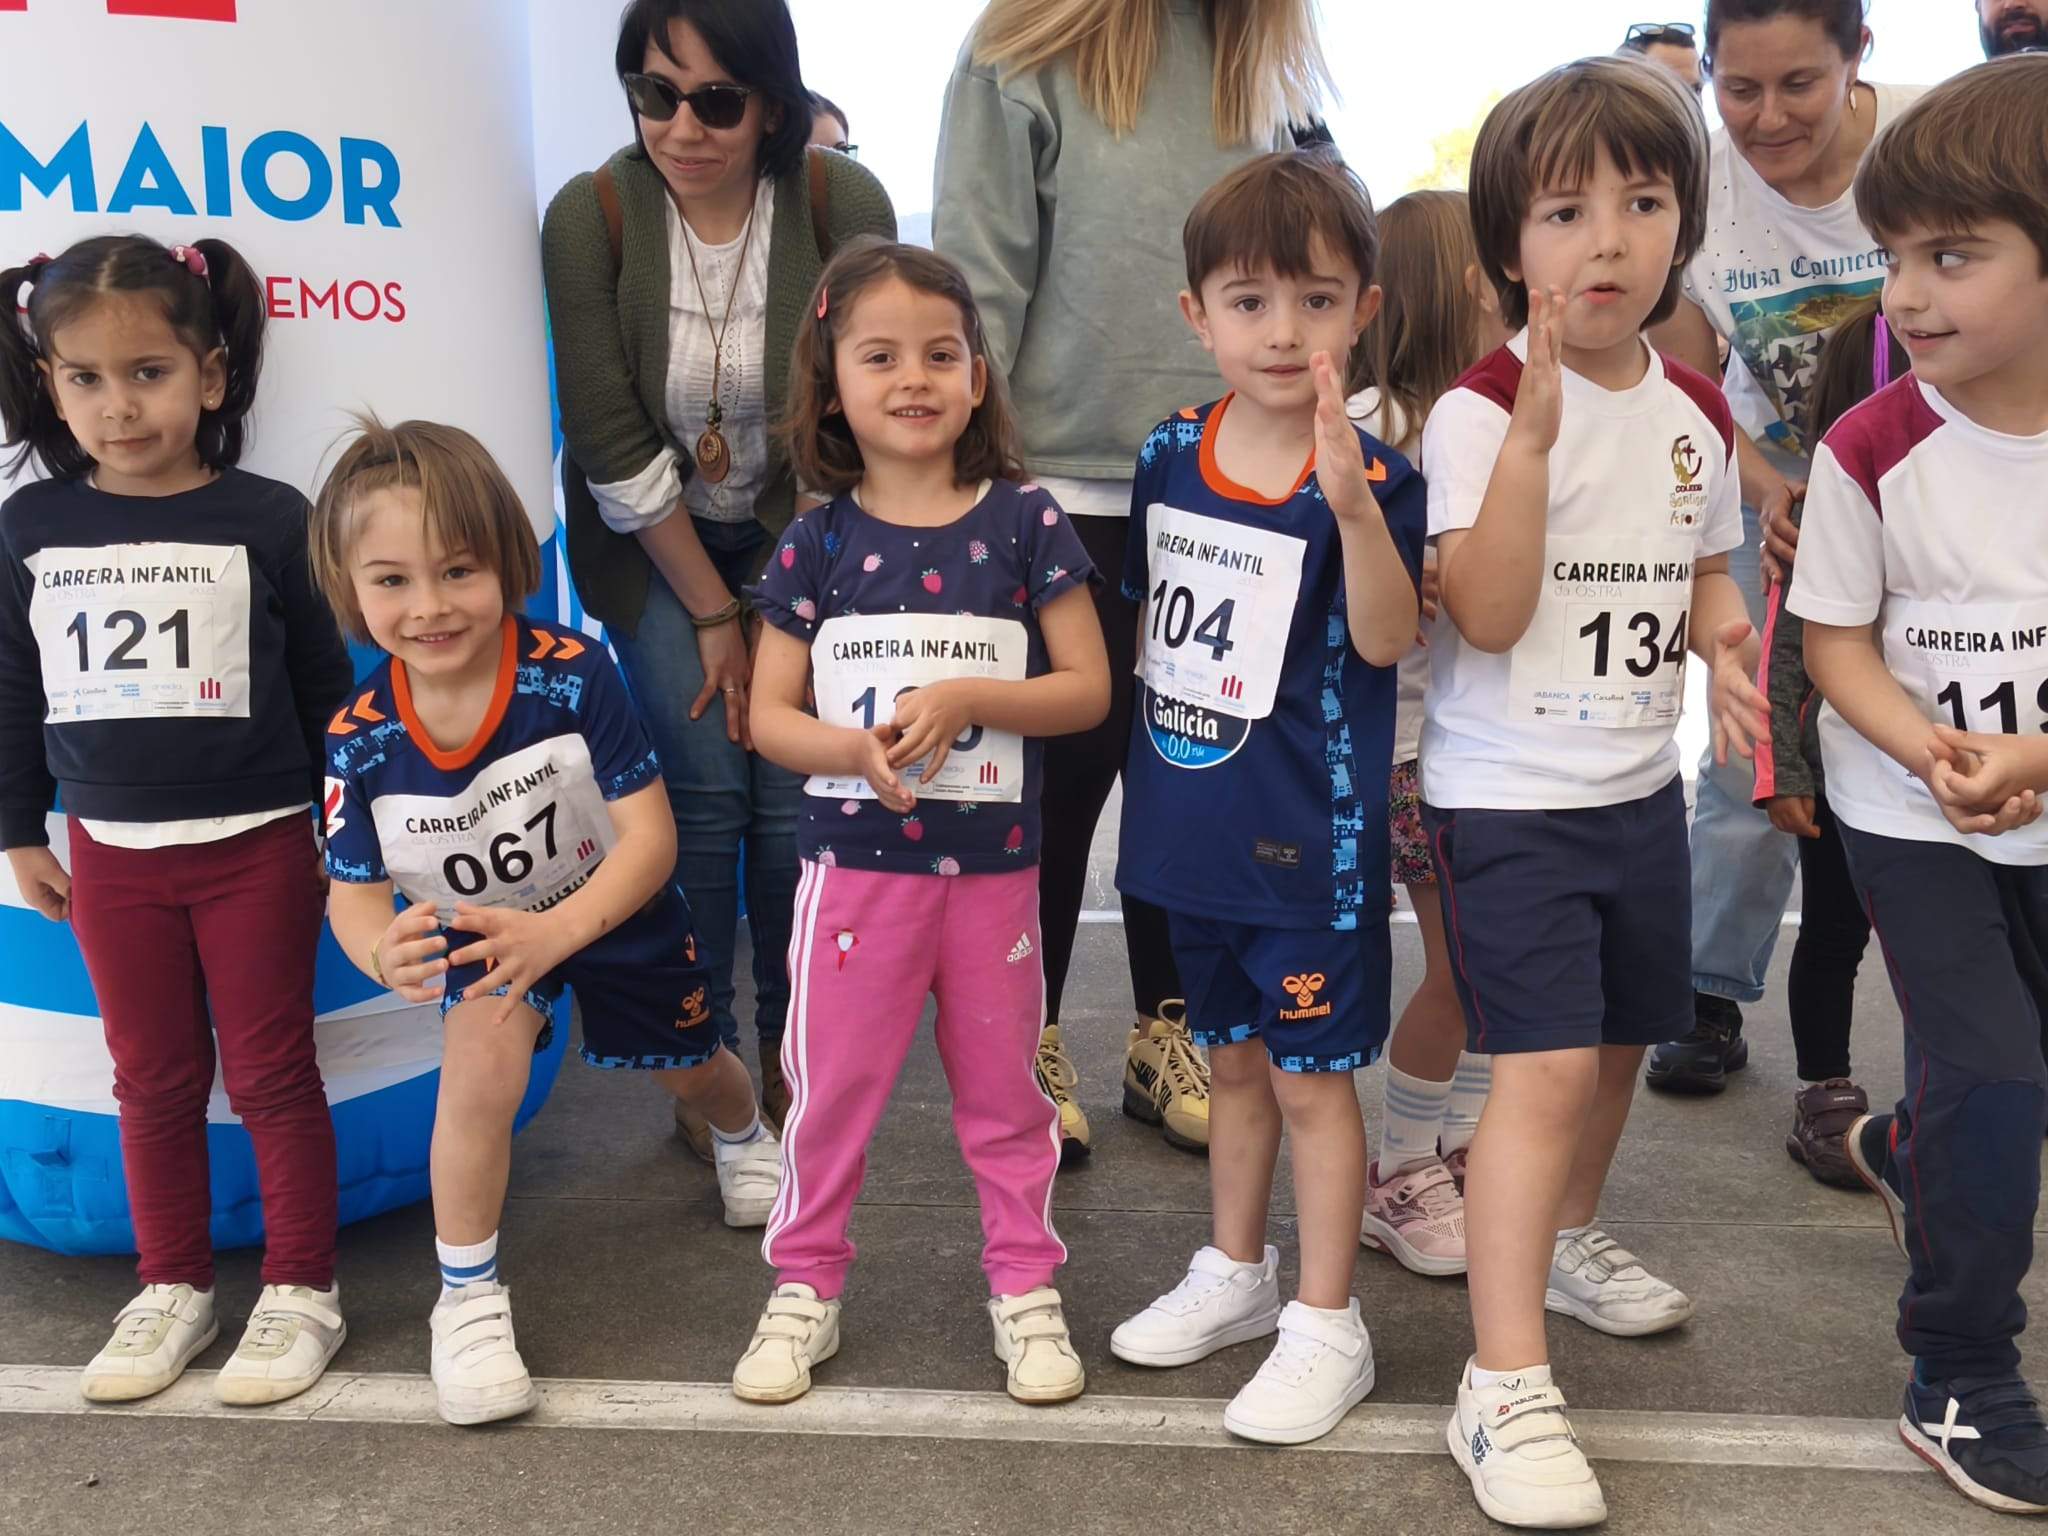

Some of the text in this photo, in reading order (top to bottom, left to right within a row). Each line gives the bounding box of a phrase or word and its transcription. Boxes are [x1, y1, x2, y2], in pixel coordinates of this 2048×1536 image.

[0, 119, 403, 228] MAIOR
[1723, 267, 1781, 292] Ibiza
[43, 566, 216, 589] CARREIRA INFANTIL
[1197, 541, 1264, 576] INFANTIL
[1553, 561, 1648, 583] CARREIRA
[1152, 579, 1236, 661] 104
[1905, 626, 2048, 652] CARREIRA INF
[66, 608, 190, 672] 121
[833, 639, 999, 663] CARREIRA INFANTIL
[1579, 610, 1687, 678] 134
[1153, 696, 1219, 740] Galicia
[406, 762, 560, 834] CARREIRA INFANTIL
[442, 800, 557, 896] 067
[1280, 1001, 1331, 1020] hummel
